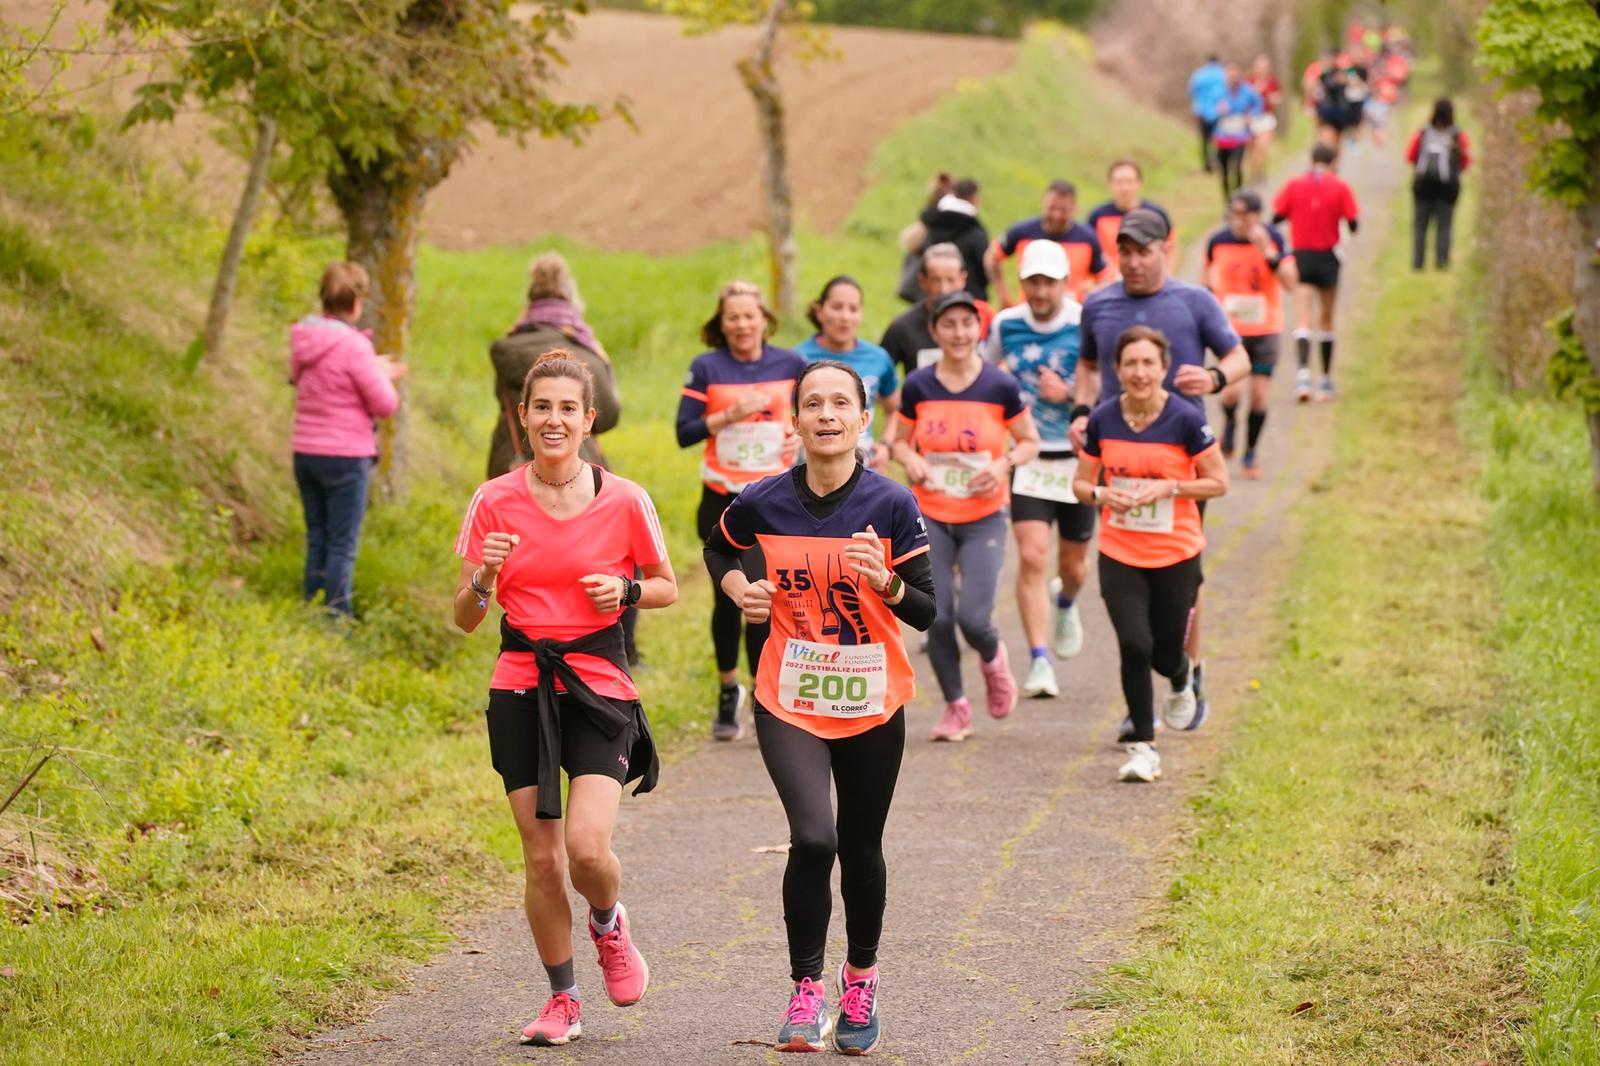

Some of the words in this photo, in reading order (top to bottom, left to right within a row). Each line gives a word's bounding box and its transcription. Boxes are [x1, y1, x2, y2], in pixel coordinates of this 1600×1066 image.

[736, 443, 766, 461] 52
[775, 568, 812, 591] 35
[789, 642, 841, 664] Vital
[785, 661, 804, 670] 2022
[805, 664, 851, 673] ESTIBALIZ
[798, 672, 867, 702] 200
[840, 704, 868, 712] CORREO
